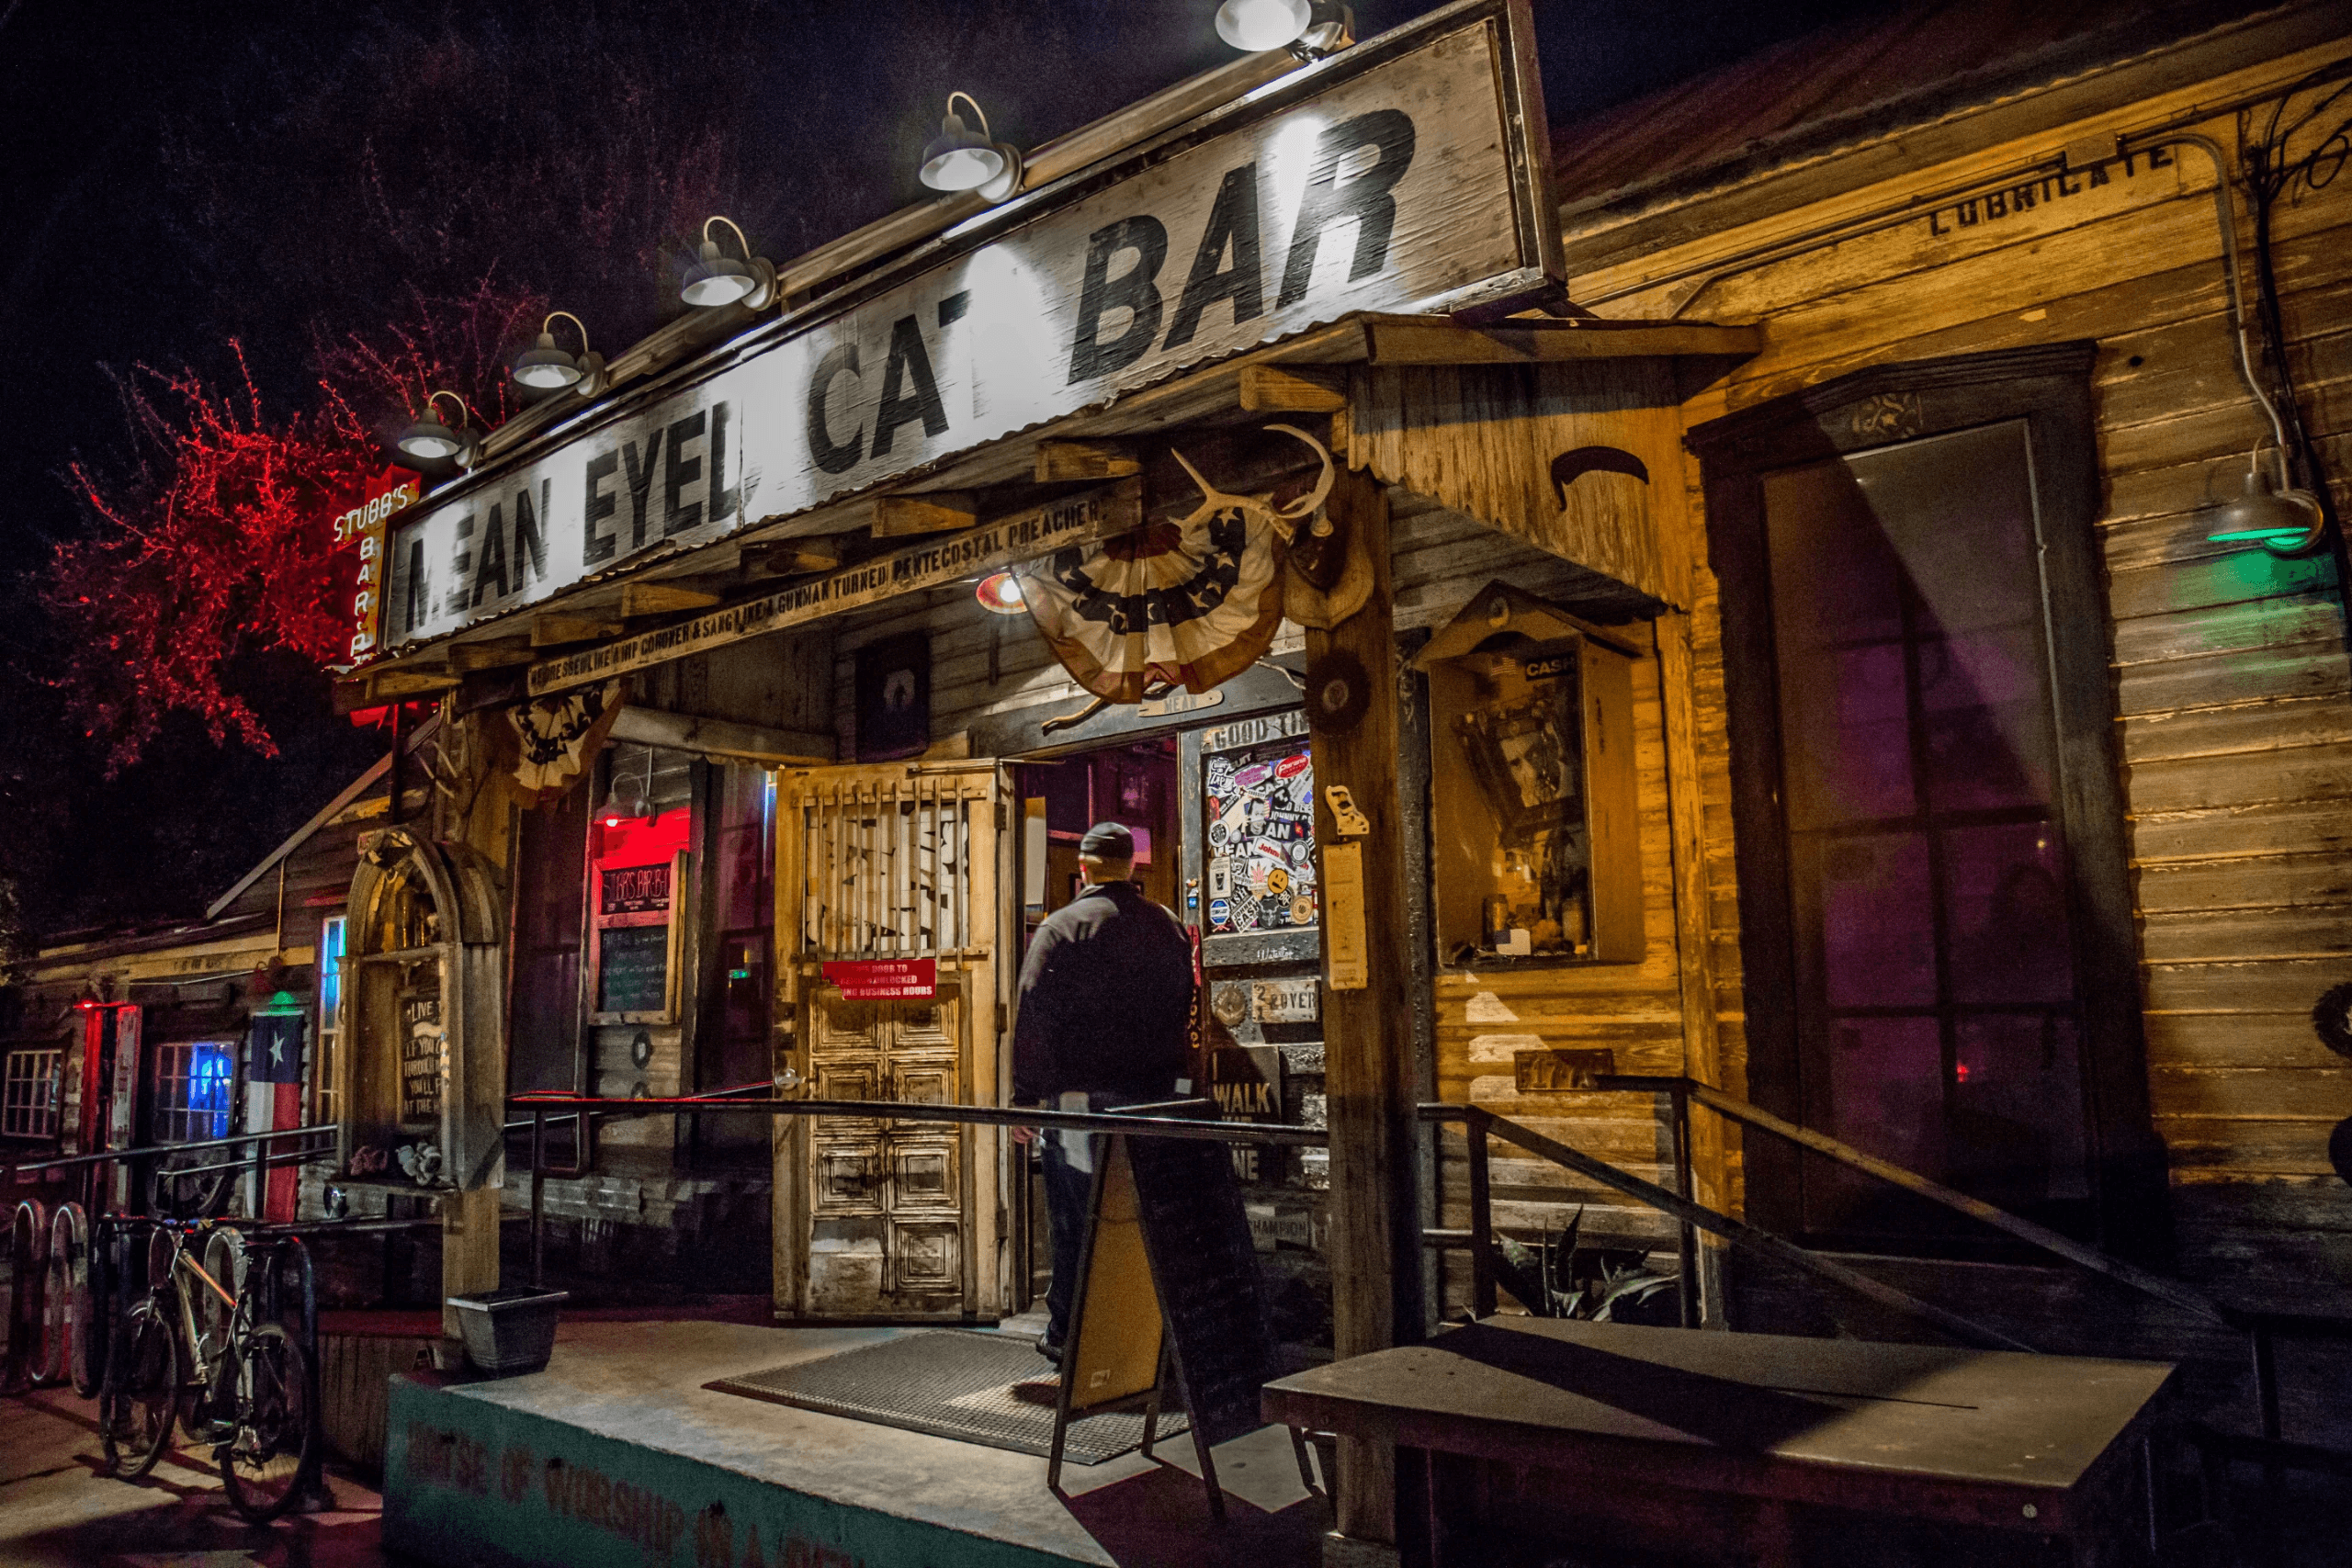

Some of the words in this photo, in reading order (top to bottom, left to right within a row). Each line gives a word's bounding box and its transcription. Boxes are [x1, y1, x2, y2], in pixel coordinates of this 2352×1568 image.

[404, 478, 551, 634] MEAN
[1067, 107, 1416, 386] BAR
[334, 483, 409, 543] STUBB'S
[692, 620, 702, 640] &
[702, 614, 733, 638] SANG
[832, 566, 888, 600] TURNED
[893, 533, 1004, 582] PENTECOSTAL
[1007, 502, 1101, 549] PREACHER
[1214, 718, 1268, 750] GOOD
[871, 964, 896, 974] DOOR
[897, 964, 909, 974] TO
[859, 987, 902, 997] BUSINESS
[902, 985, 933, 997] HOURS
[1213, 1082, 1272, 1113] WALK
